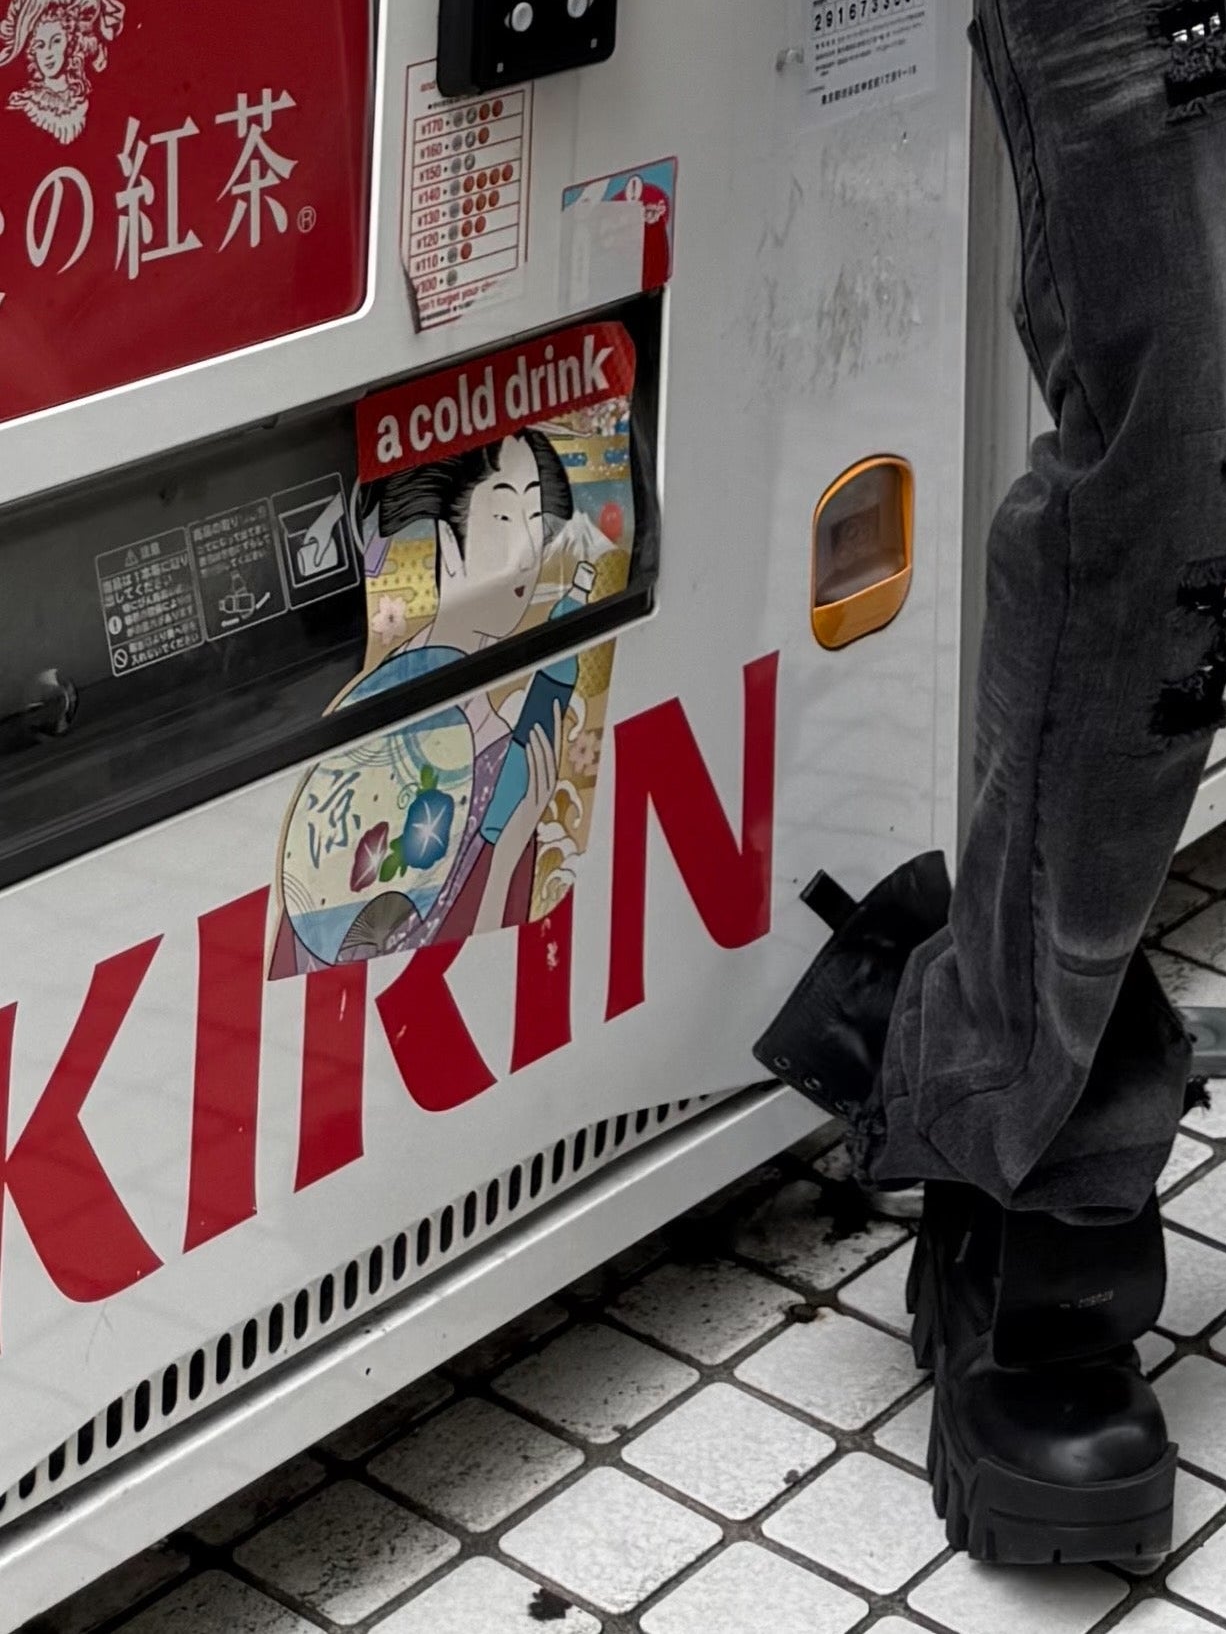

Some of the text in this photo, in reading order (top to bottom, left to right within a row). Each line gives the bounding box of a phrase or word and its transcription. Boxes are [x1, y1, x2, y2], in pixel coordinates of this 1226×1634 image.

[0, 88, 299, 280] の紅茶
[376, 333, 616, 464] a cold drink
[304, 770, 363, 869] 涼
[0, 650, 781, 1304] KIRIN
